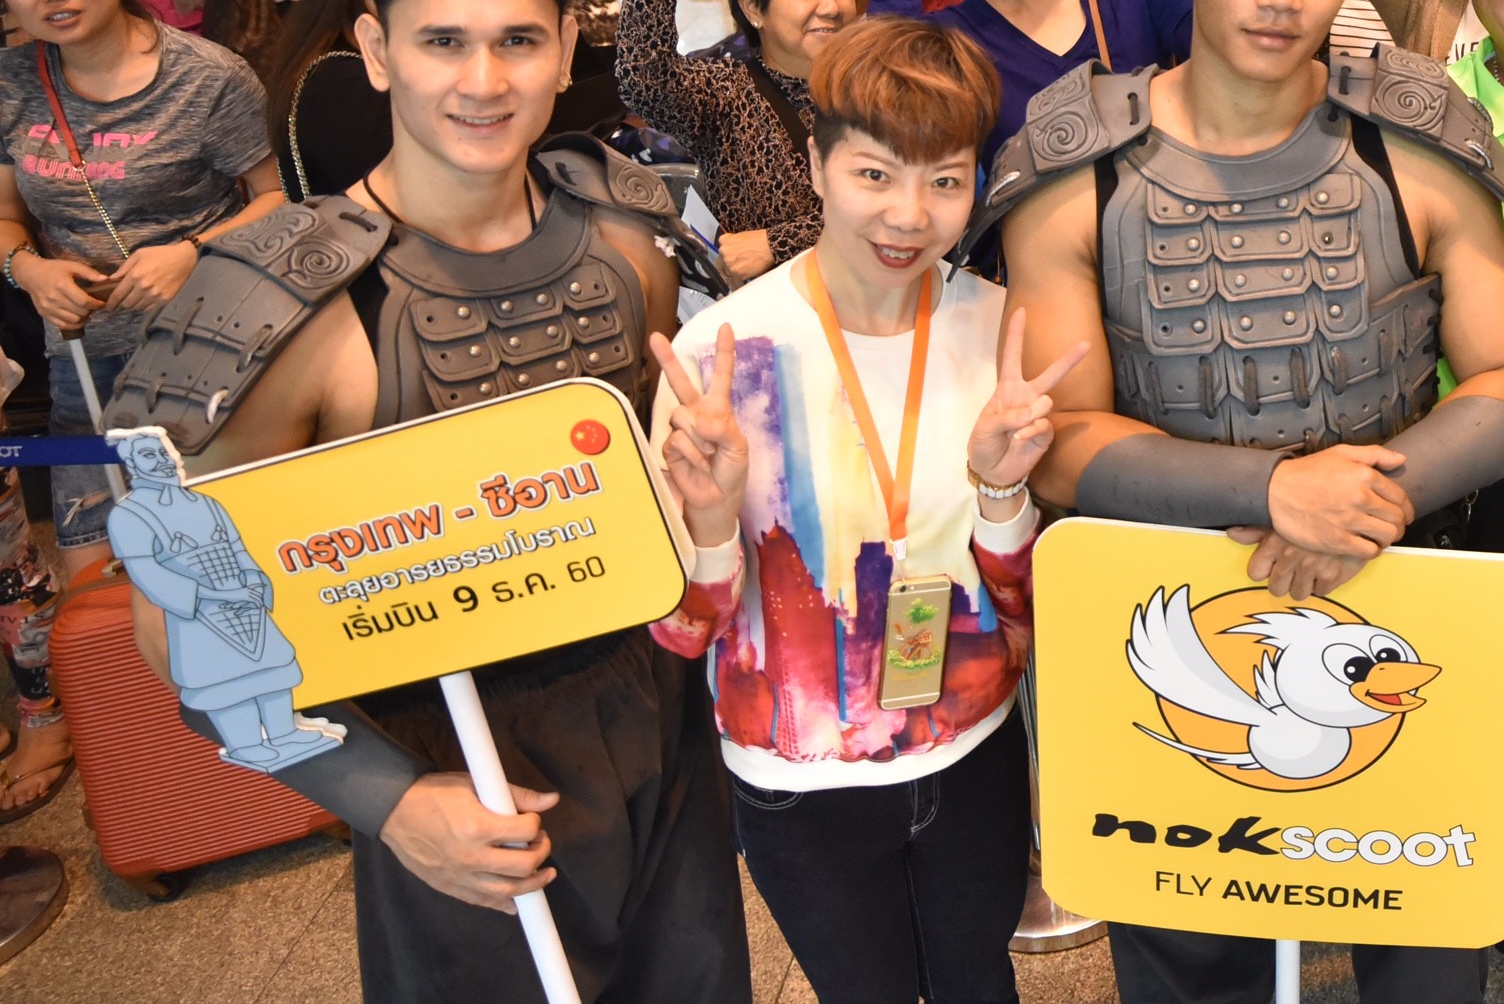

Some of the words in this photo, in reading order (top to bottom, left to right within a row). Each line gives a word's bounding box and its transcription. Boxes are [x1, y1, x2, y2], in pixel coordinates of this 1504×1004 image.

[276, 502, 444, 573] กรุงเทพ
[318, 516, 597, 604] ตะลุยอารยธรรมโบราณ
[341, 600, 440, 642] เริ่มบิน
[452, 584, 480, 613] 9
[491, 572, 557, 604] ธ.ค.
[566, 554, 607, 584] 60
[1091, 812, 1476, 867] nokscoot
[1155, 871, 1213, 897] FLY
[1221, 879, 1403, 911] AWESOME
